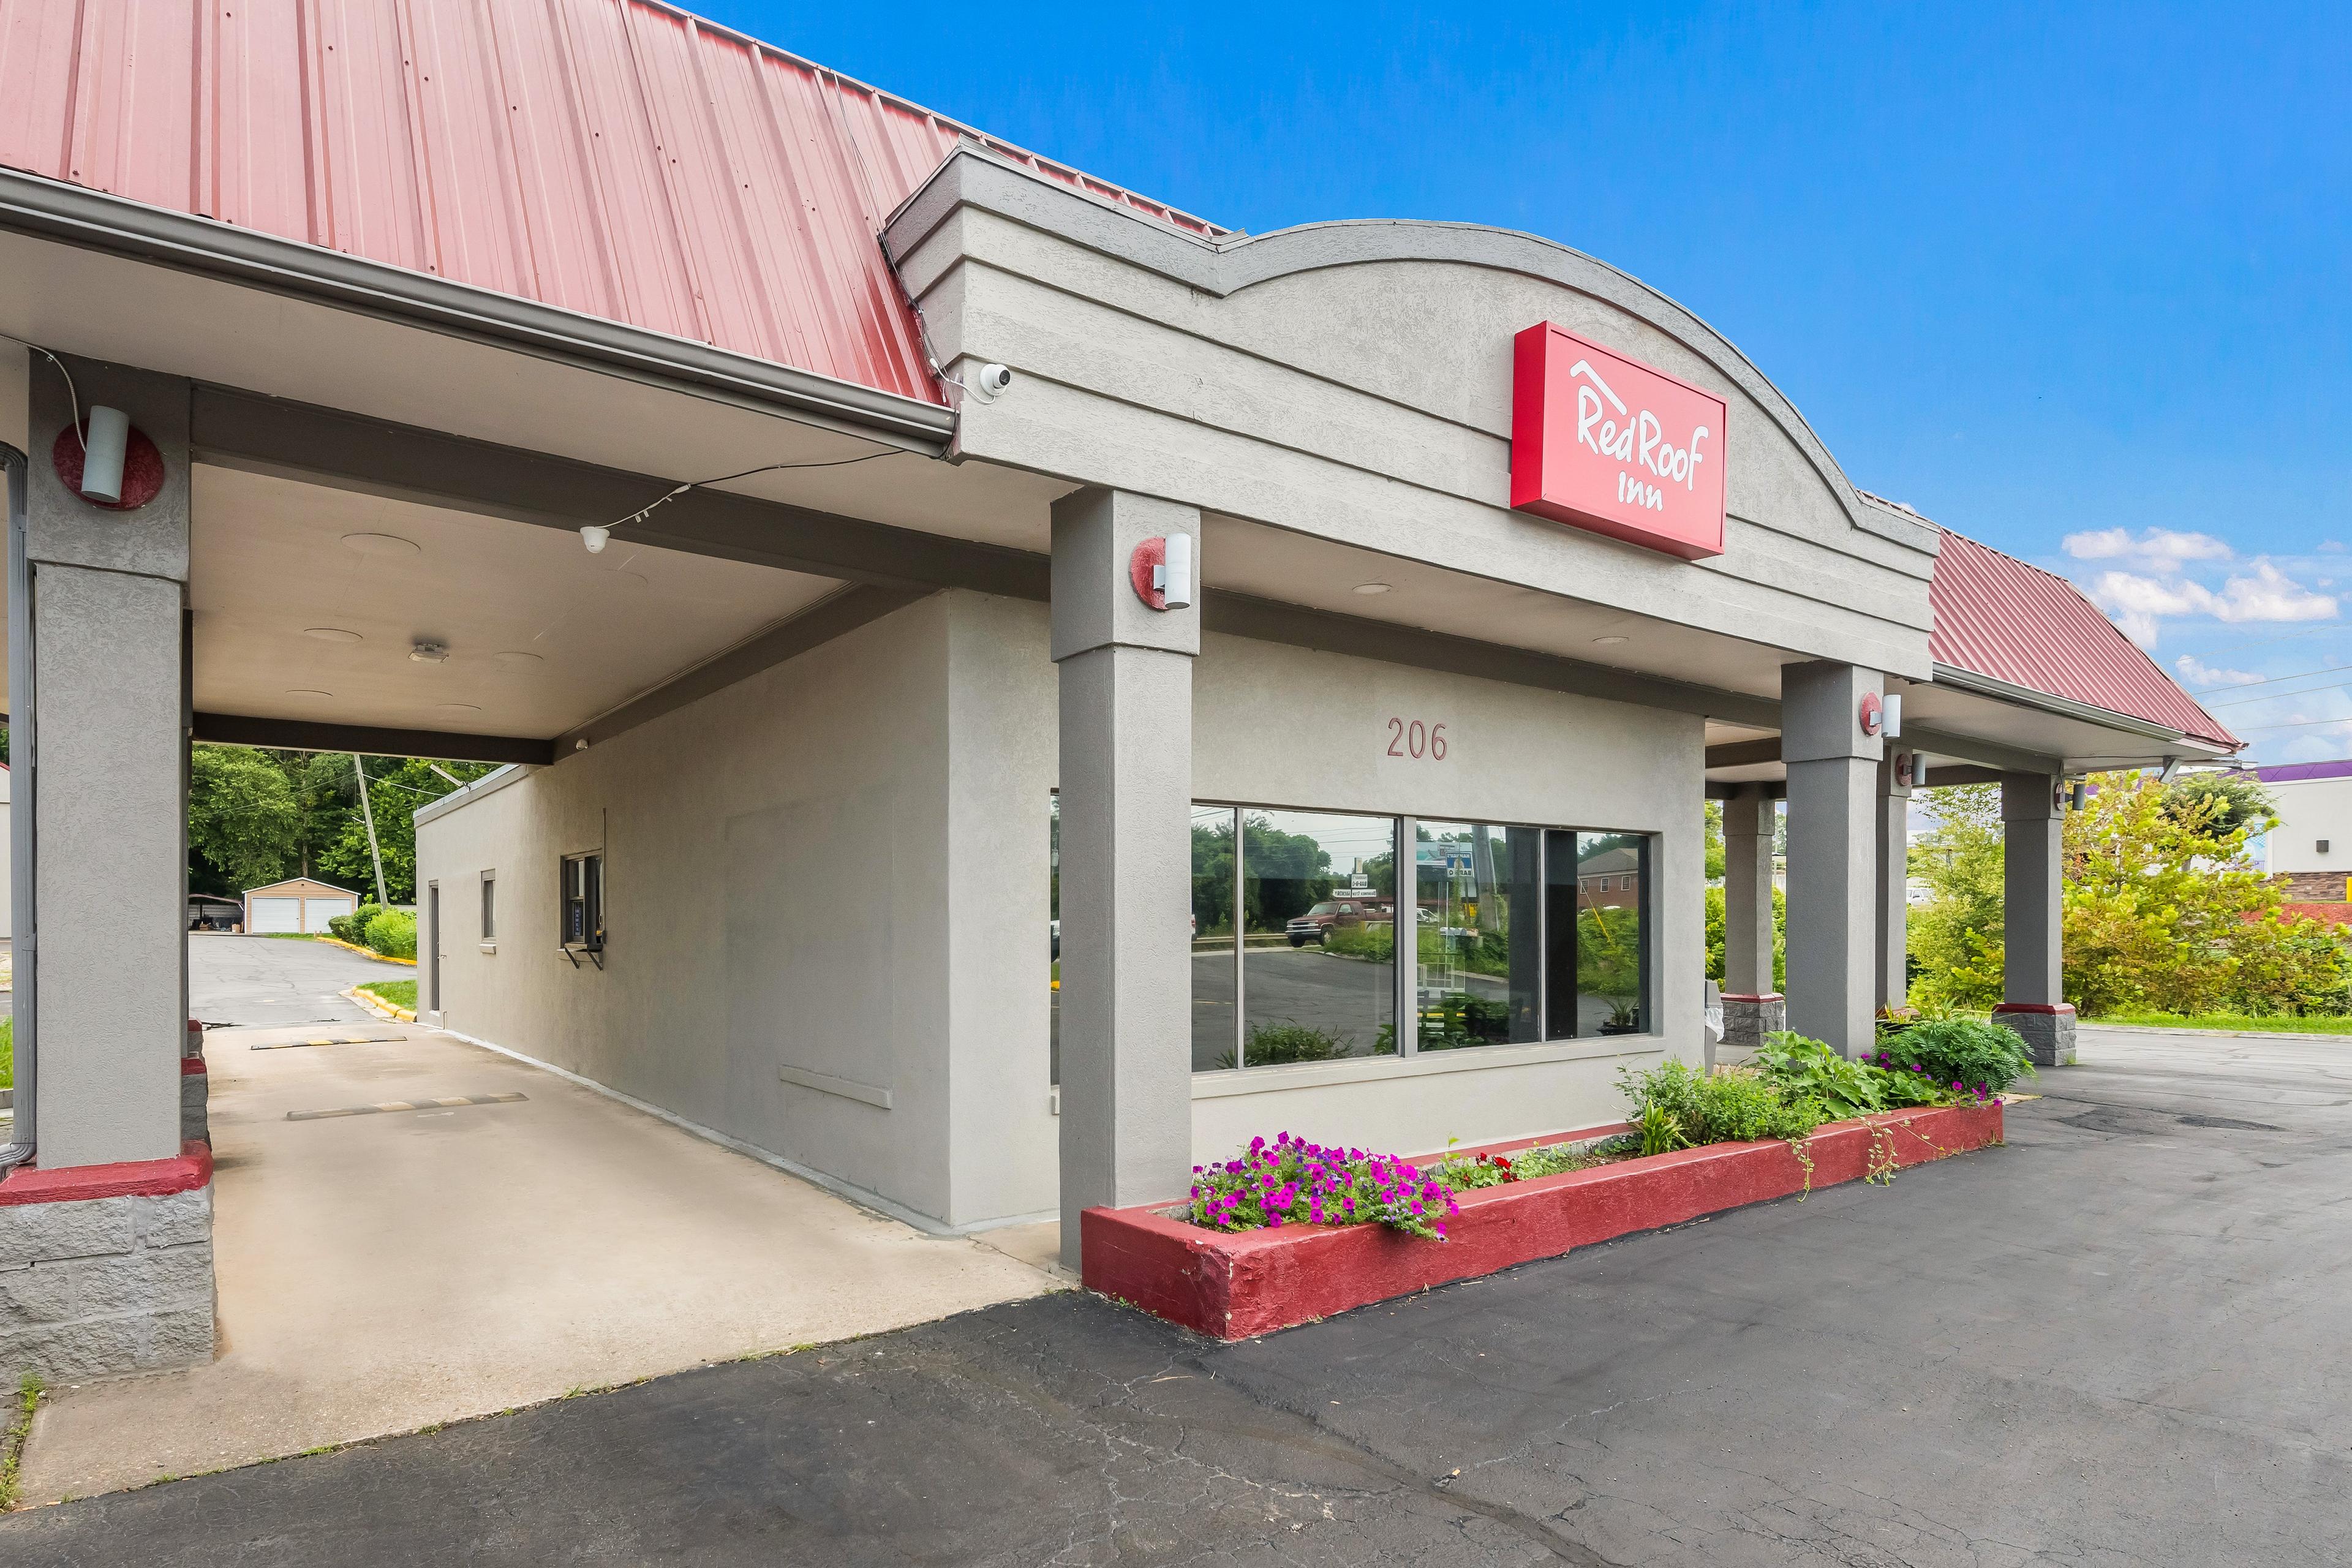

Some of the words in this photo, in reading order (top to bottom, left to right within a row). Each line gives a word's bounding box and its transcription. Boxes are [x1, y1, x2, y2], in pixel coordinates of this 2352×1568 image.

[1578, 385, 1637, 463] Red
[1638, 409, 1709, 491] Roof
[1387, 717, 1447, 761] 206
